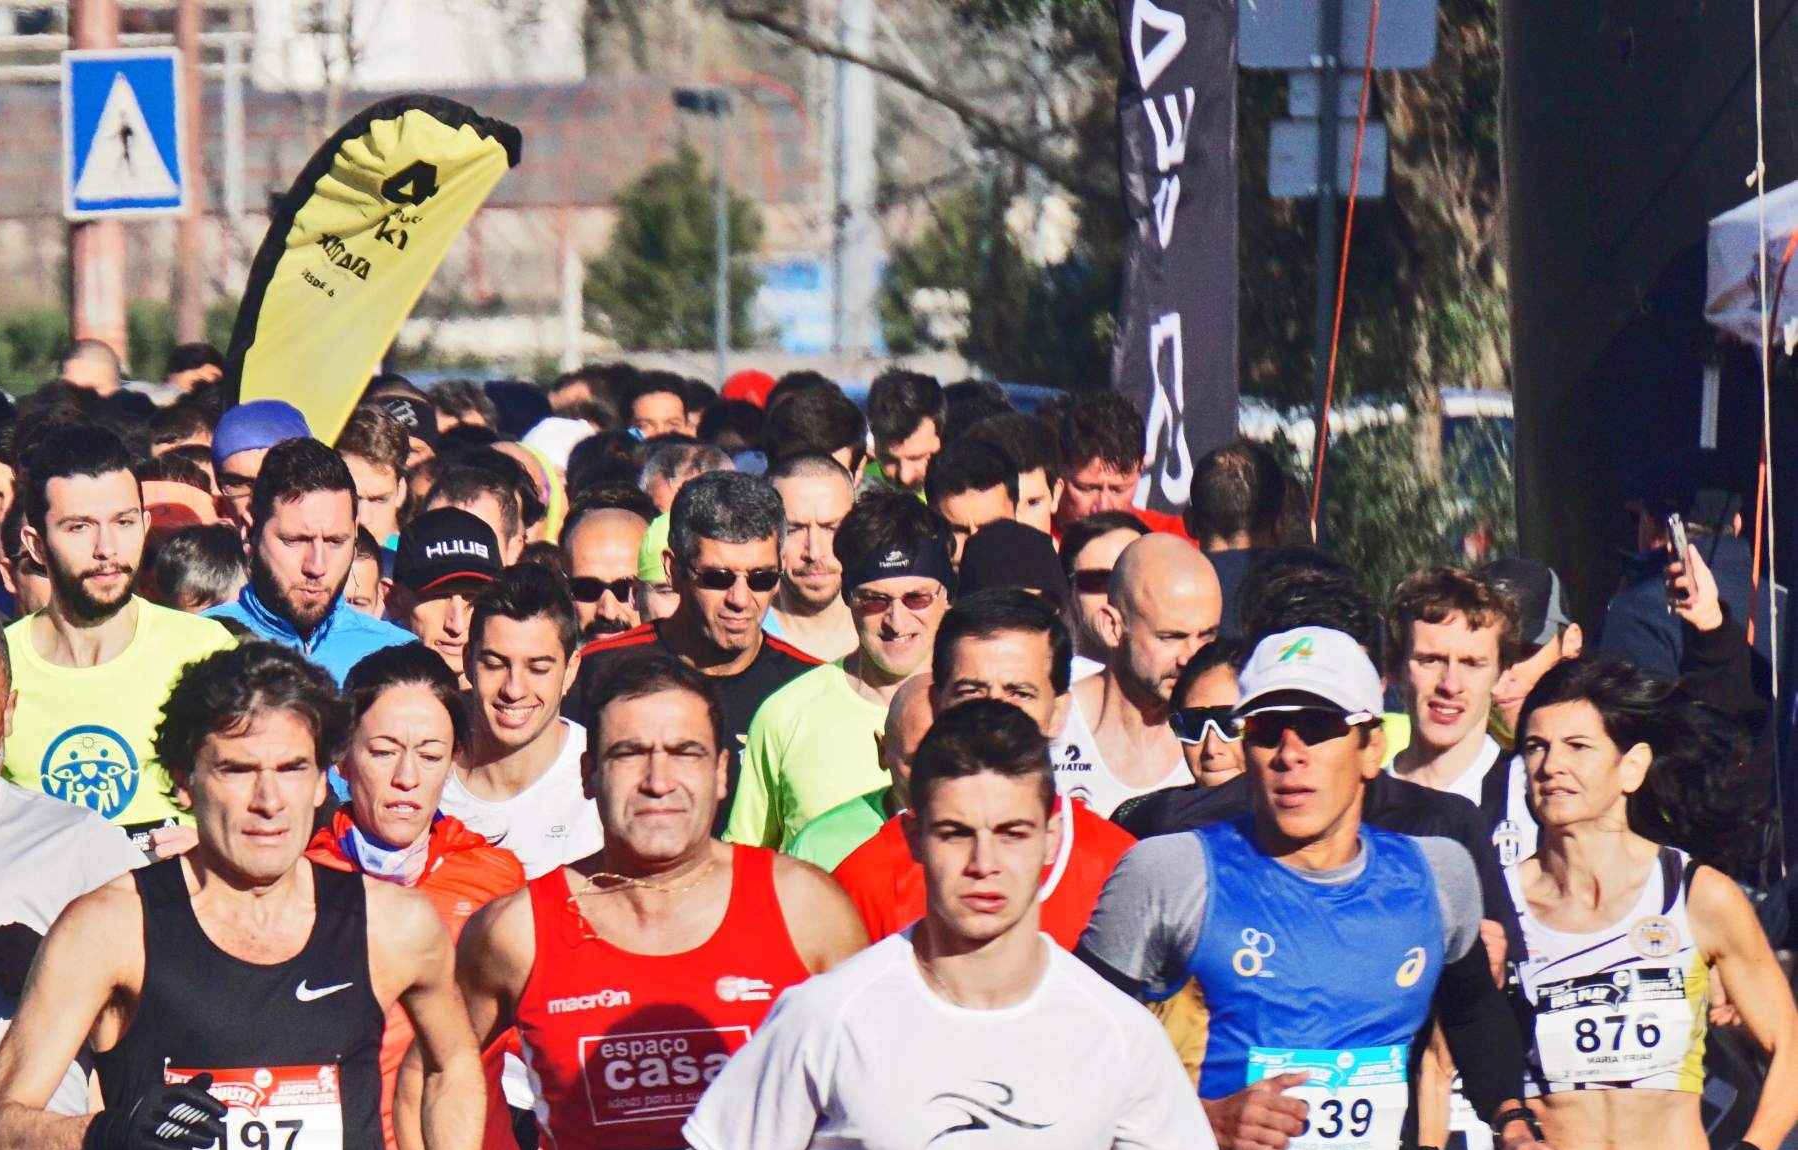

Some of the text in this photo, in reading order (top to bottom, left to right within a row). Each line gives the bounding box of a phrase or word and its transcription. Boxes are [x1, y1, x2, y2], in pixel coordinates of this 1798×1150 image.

[426, 540, 489, 559] HUUB
[548, 988, 631, 1014] macron
[1575, 1012, 1661, 1053] 876
[601, 1037, 688, 1059] espaço
